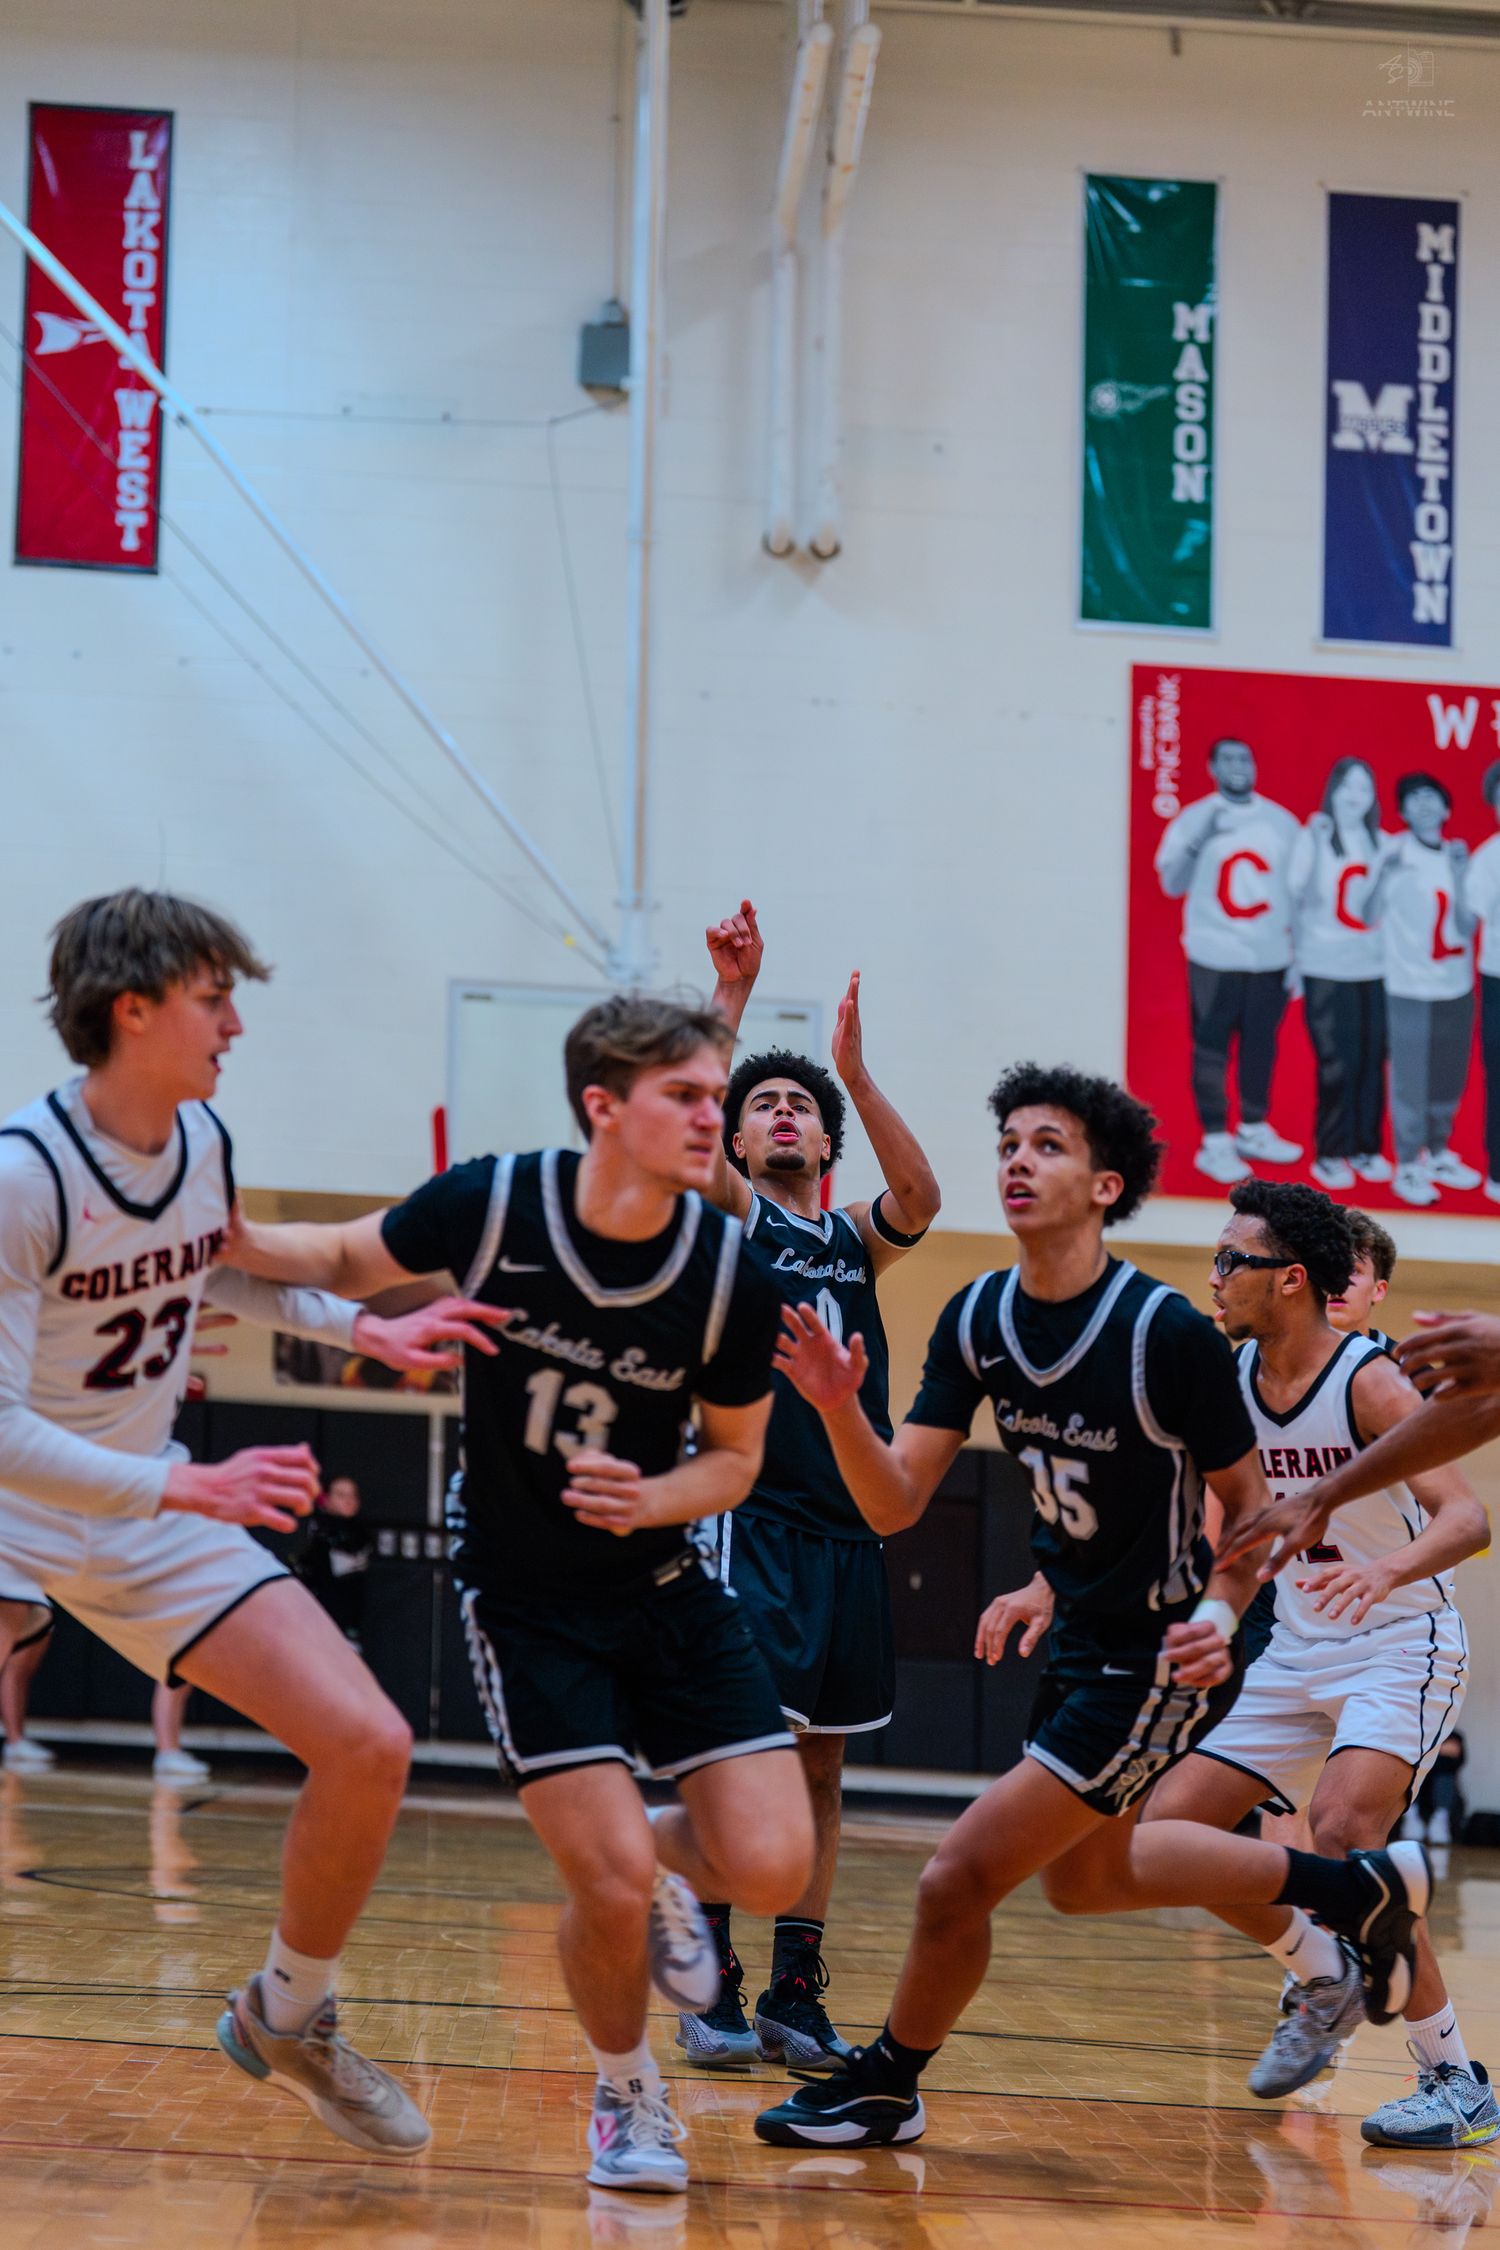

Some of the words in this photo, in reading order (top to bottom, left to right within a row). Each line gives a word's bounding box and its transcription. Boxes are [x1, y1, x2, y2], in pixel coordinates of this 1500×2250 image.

[119, 131, 158, 371] LAKOTA
[1171, 302, 1214, 503] MASON
[1411, 223, 1456, 624] MIDDLETOWN
[115, 389, 155, 552] WEST
[1217, 850, 1271, 919] C
[770, 1247, 834, 1279] Lakota
[834, 1258, 867, 1285] East
[83, 1296, 192, 1390] 23
[523, 1368, 619, 1460] 13
[1062, 1412, 1119, 1452] East
